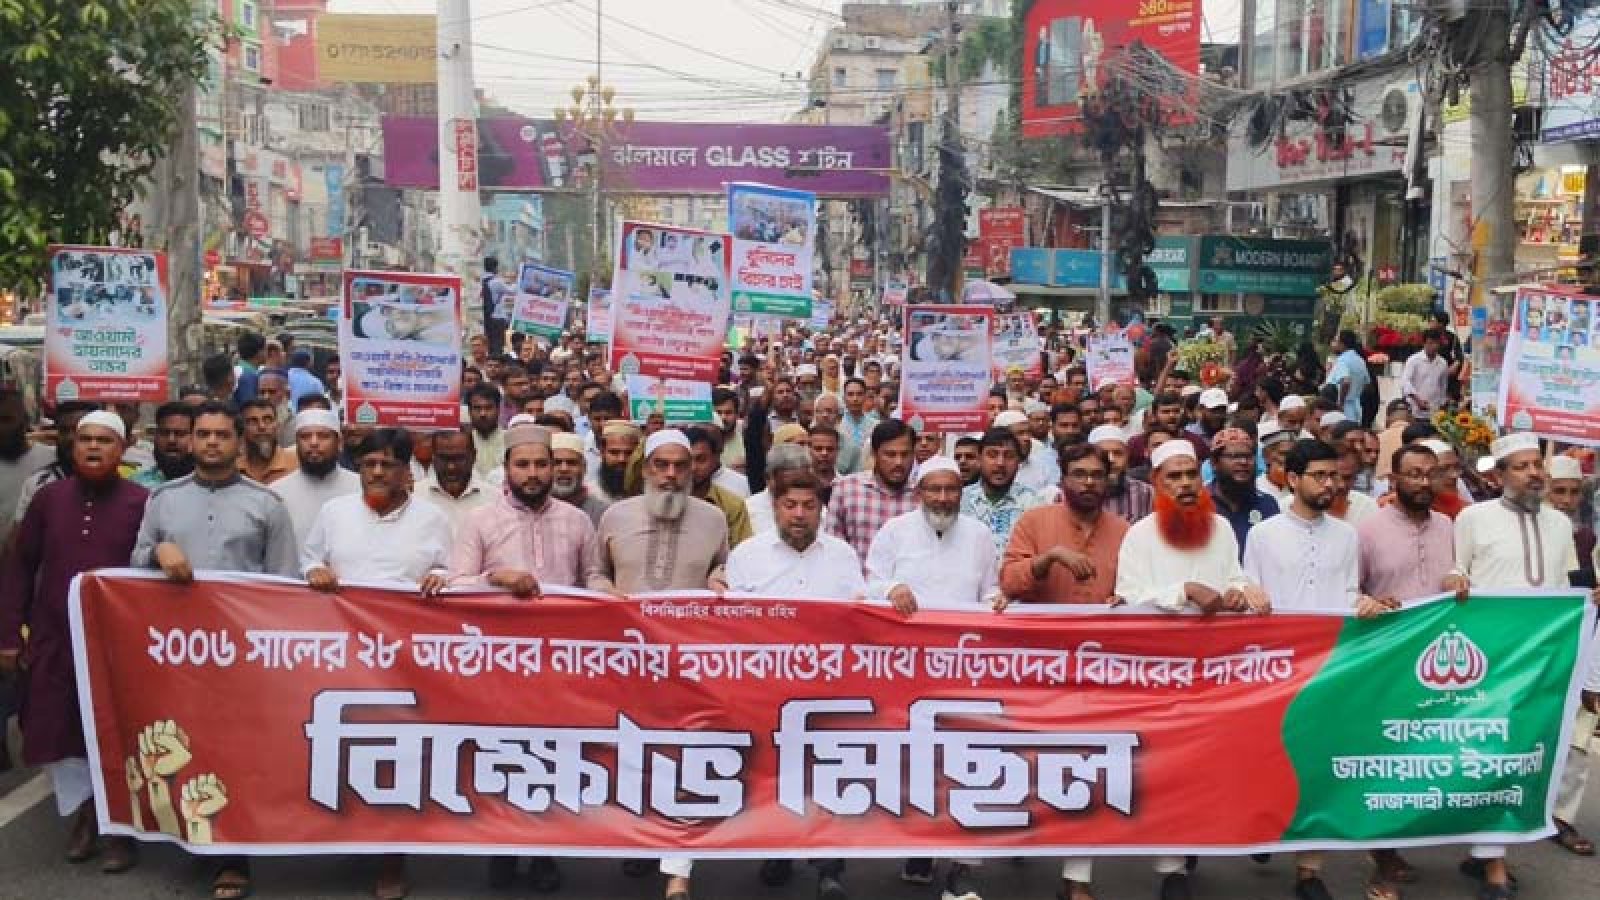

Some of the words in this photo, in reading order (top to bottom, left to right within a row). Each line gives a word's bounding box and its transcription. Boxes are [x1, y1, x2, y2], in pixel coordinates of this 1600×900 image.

[705, 145, 790, 169] GLASS
[1235, 250, 1280, 265] MODERN
[147, 626, 237, 666] ২০০৬
[246, 629, 349, 671] সালের
[358, 631, 402, 669] ২৮
[412, 623, 542, 676] অক্টোবর
[549, 629, 670, 682] নারকীয়
[678, 643, 845, 682] হত্যাকাণ্ডের
[851, 644, 917, 681] সাথে
[925, 633, 1068, 686] জড়িতদের
[1075, 641, 1196, 688] বিচারের
[1202, 644, 1294, 685] দাবীতে
[1382, 717, 1509, 743] বাংলাদেশ
[304, 689, 751, 819] বিক্ষোভ
[774, 699, 1139, 829] মিছিল
[1331, 755, 1454, 781] জামায়াতে
[1460, 742, 1545, 779] ইসলামী
[1363, 787, 1443, 810] রাজশাহী
[1447, 785, 1523, 808] মহানগরী
